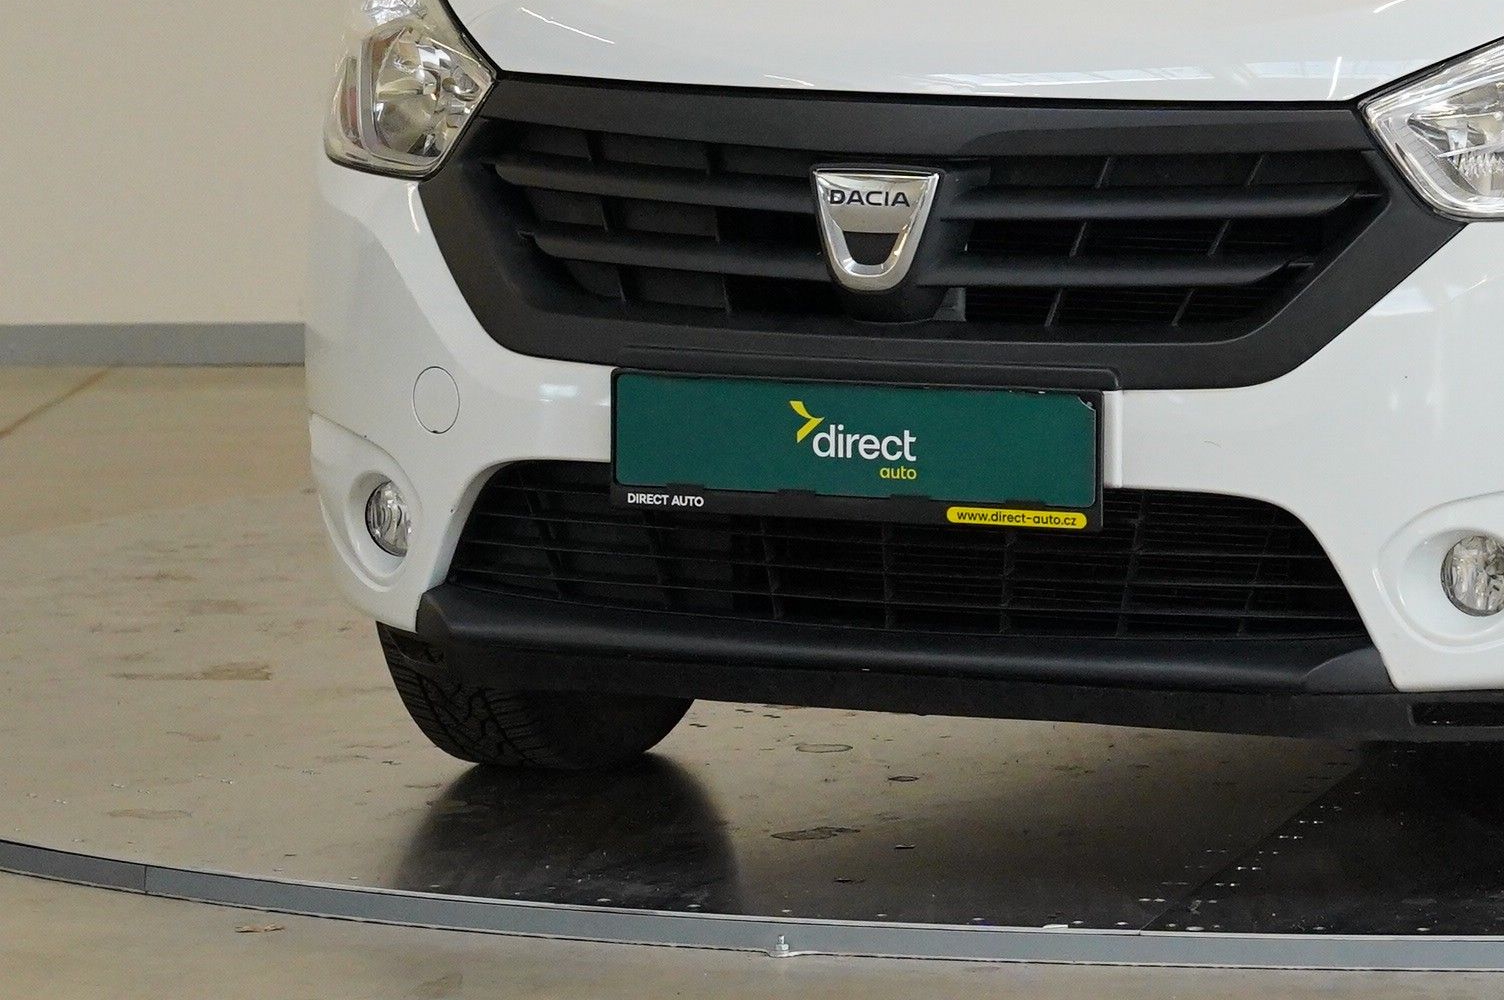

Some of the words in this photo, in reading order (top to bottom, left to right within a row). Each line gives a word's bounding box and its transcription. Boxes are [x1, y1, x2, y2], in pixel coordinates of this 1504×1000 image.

[829, 189, 911, 207] DACIA
[812, 424, 917, 462] direct
[879, 465, 917, 480] auto
[627, 492, 670, 505] DIRECT
[671, 495, 705, 507] AUTO
[956, 511, 1077, 526] www.direct-auto.cz
